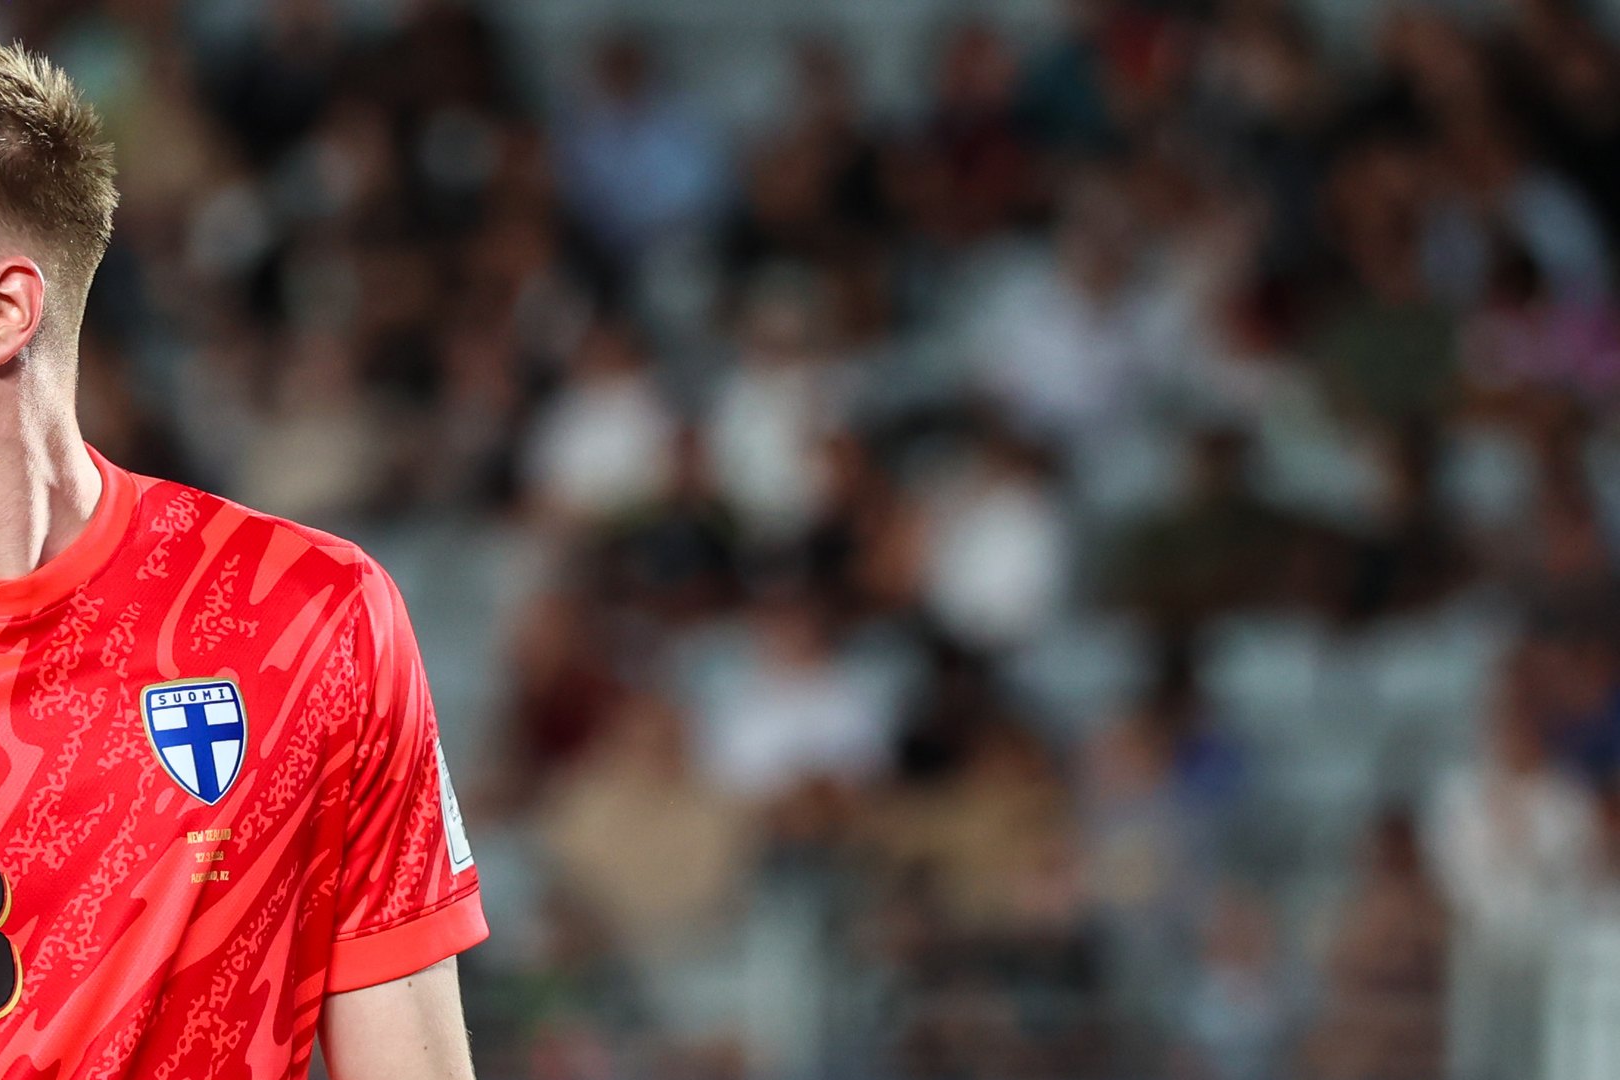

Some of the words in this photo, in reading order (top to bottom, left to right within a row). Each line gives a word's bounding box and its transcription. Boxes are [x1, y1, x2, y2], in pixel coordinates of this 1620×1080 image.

[158, 689, 225, 705] SUOMI
[187, 830, 204, 844] NEW
[220, 870, 230, 881] NZ
